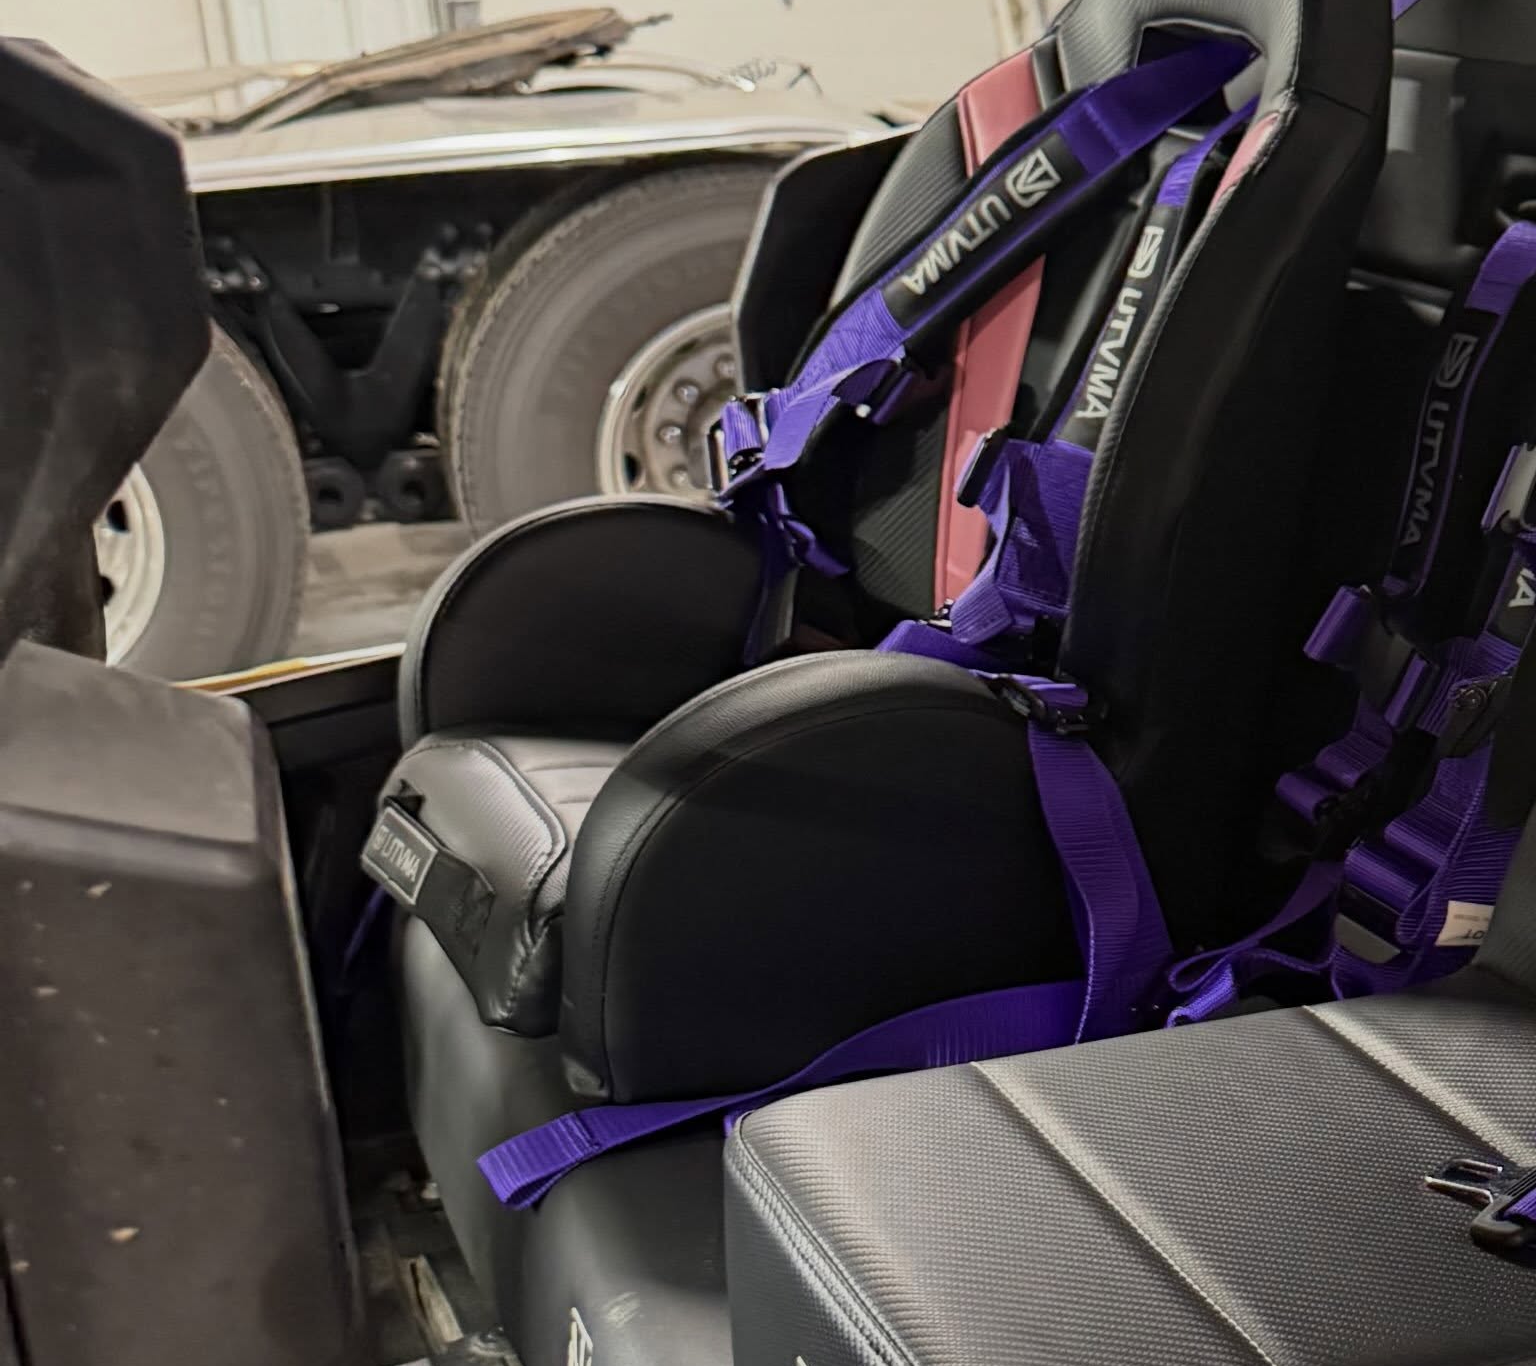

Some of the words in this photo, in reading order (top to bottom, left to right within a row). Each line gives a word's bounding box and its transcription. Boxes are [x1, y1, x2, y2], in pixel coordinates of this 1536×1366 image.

[902, 194, 1012, 296] UTVMA
[1074, 286, 1143, 419] UTVMA
[1401, 400, 1449, 546] UTVMA
[381, 833, 420, 882] UTVMA
